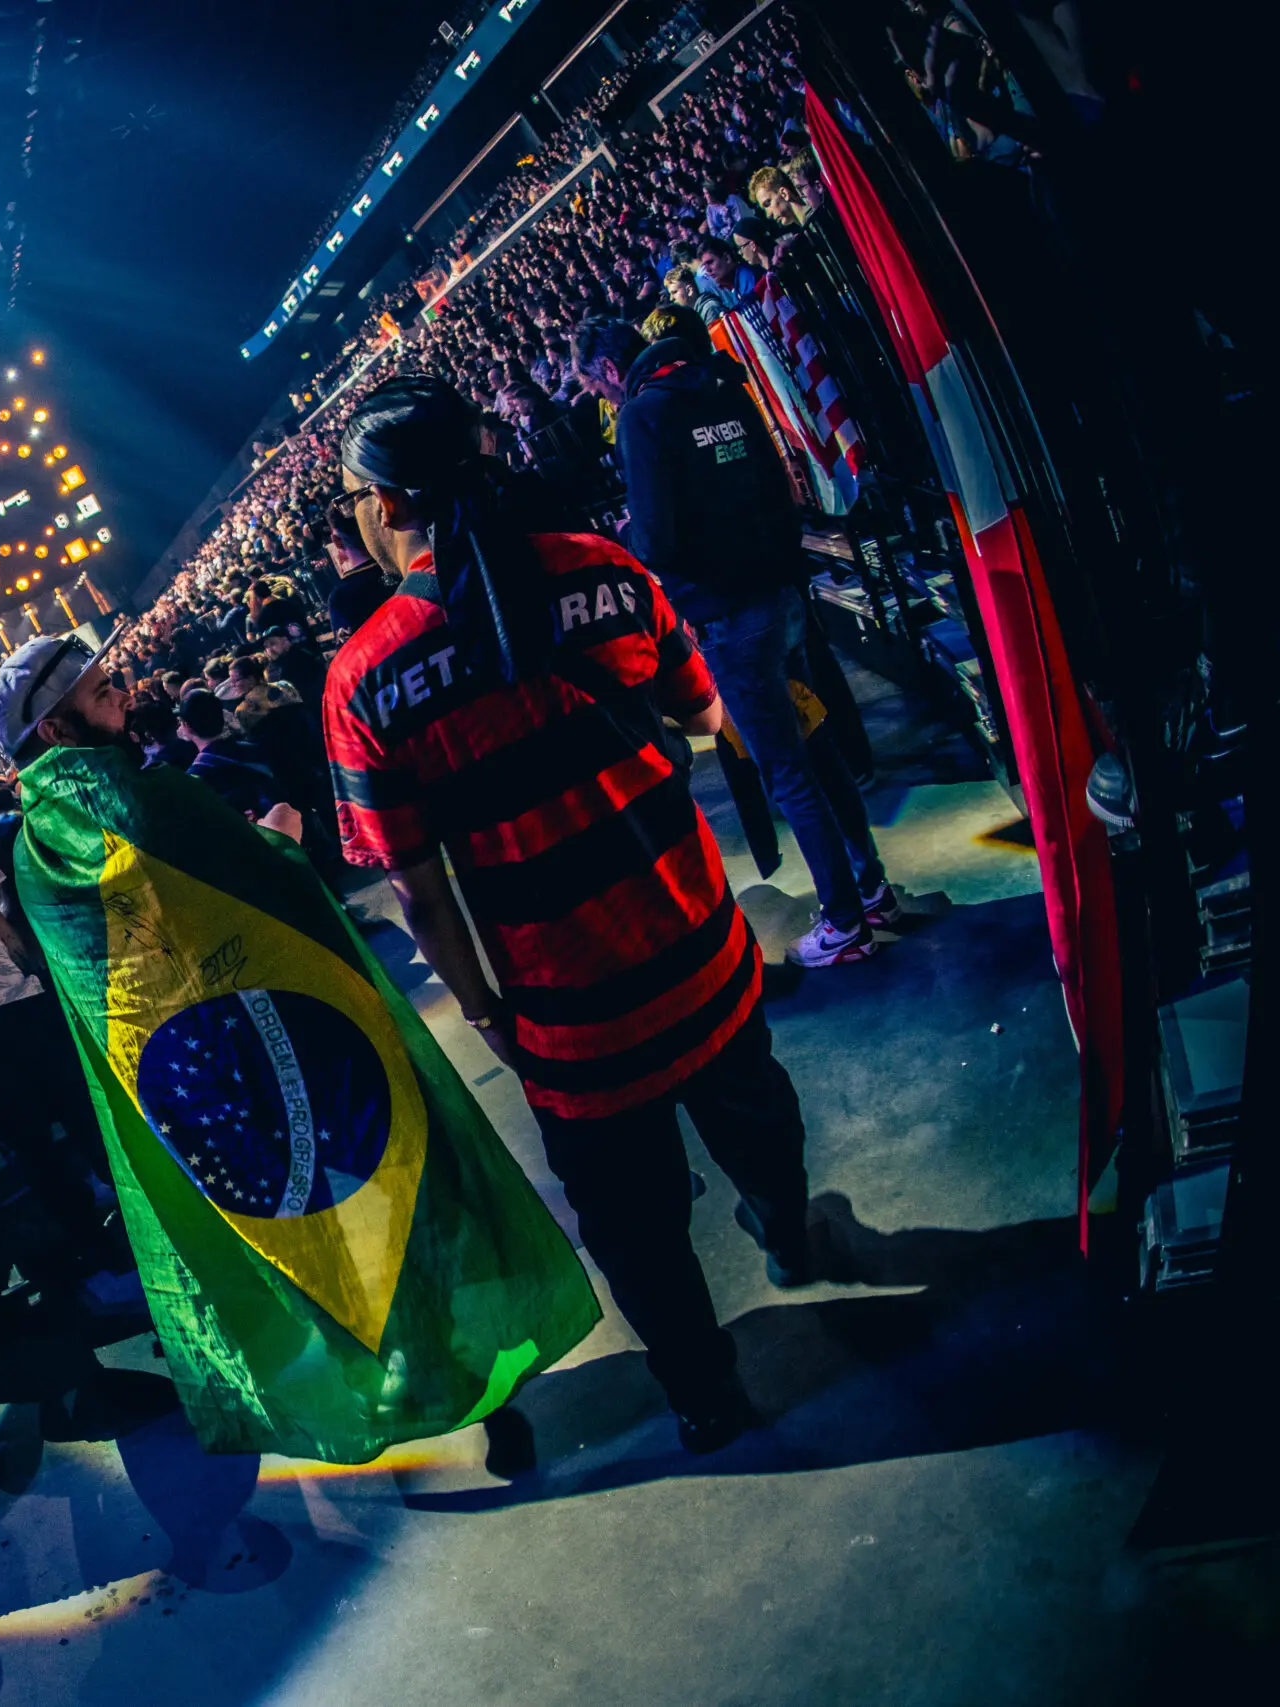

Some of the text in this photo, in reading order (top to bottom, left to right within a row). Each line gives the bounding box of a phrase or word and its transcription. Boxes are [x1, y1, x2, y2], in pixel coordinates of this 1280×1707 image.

[692, 420, 747, 448] SKYBOX
[715, 439, 747, 464] EDGE
[252, 998, 296, 1071] ORDEM
[286, 1098, 311, 1211] PROGRESSO
